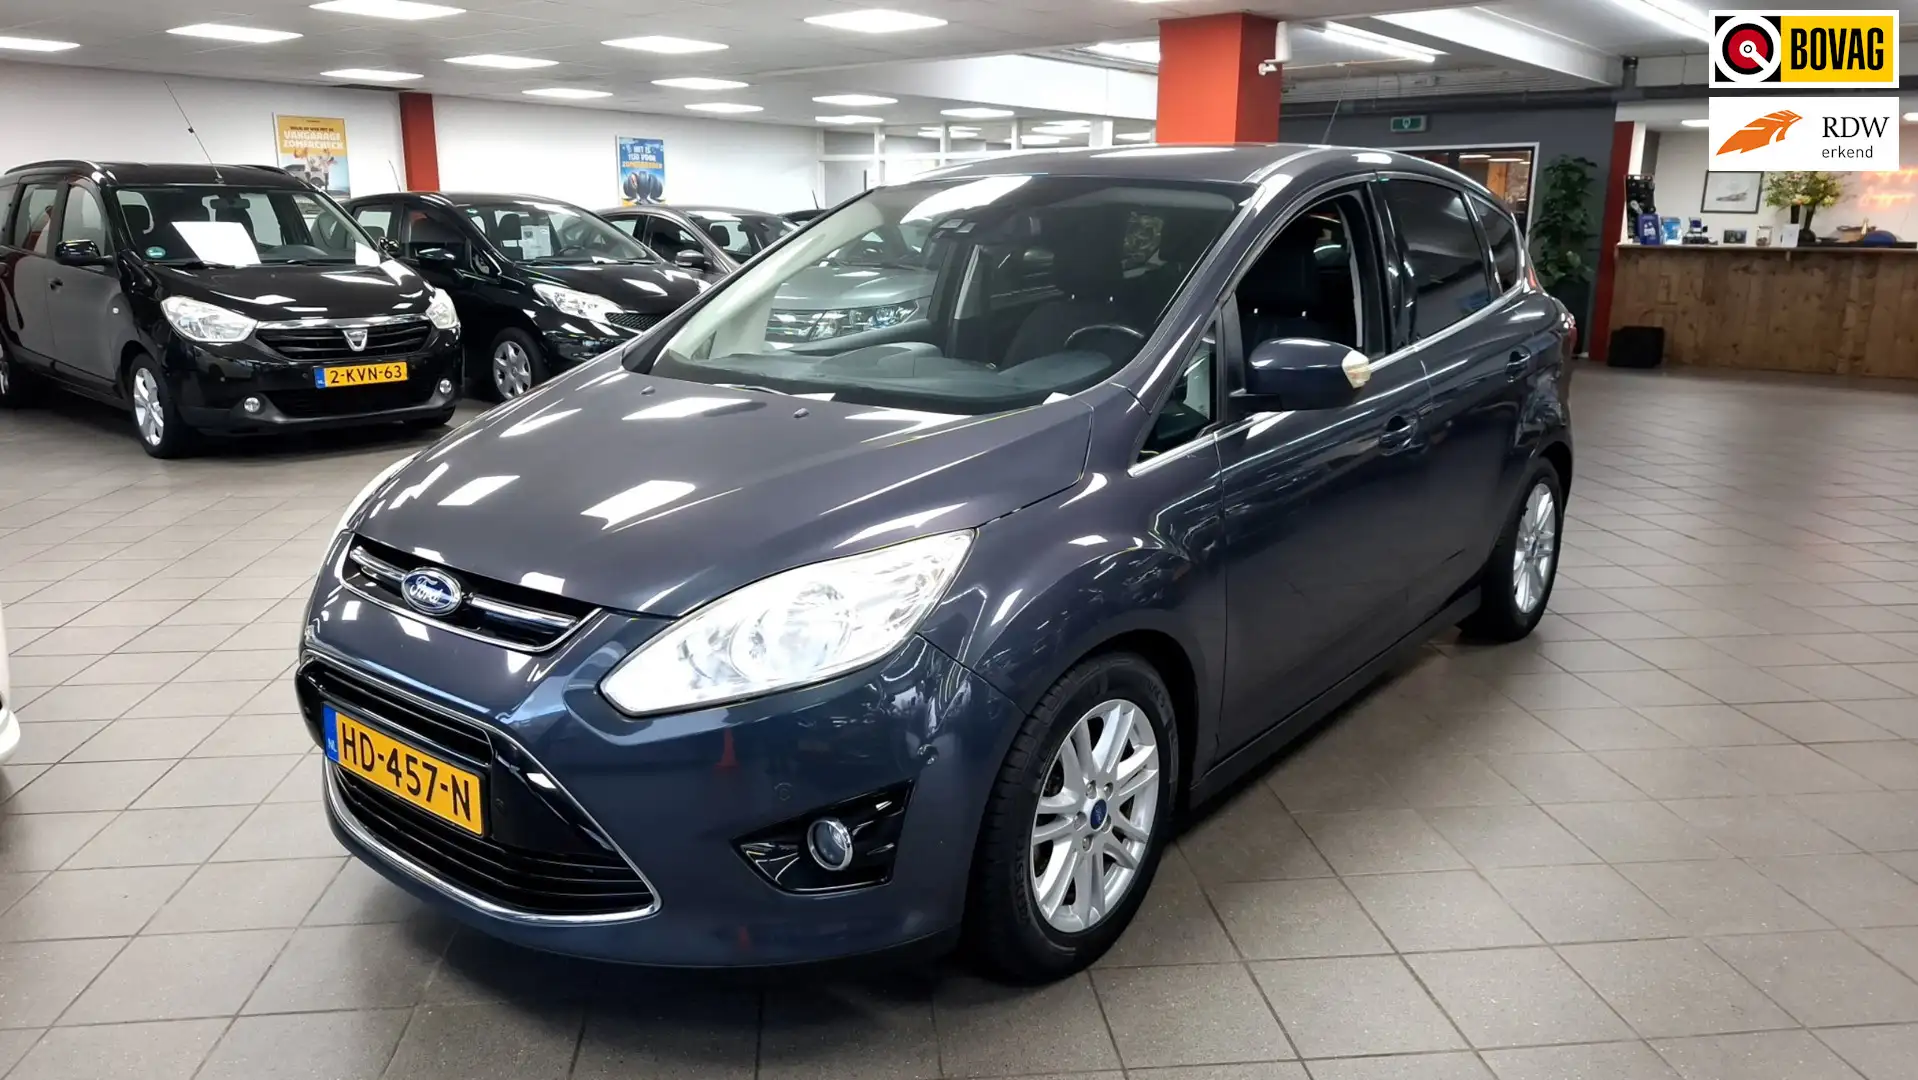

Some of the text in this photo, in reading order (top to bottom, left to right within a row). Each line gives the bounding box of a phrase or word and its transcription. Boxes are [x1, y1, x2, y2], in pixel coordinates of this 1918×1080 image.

[283, 130, 340, 141] VAKGARAGE
[329, 365, 402, 384] 2-KVN-63
[410, 576, 443, 603] Ford
[341, 722, 471, 822] HD-457-N
